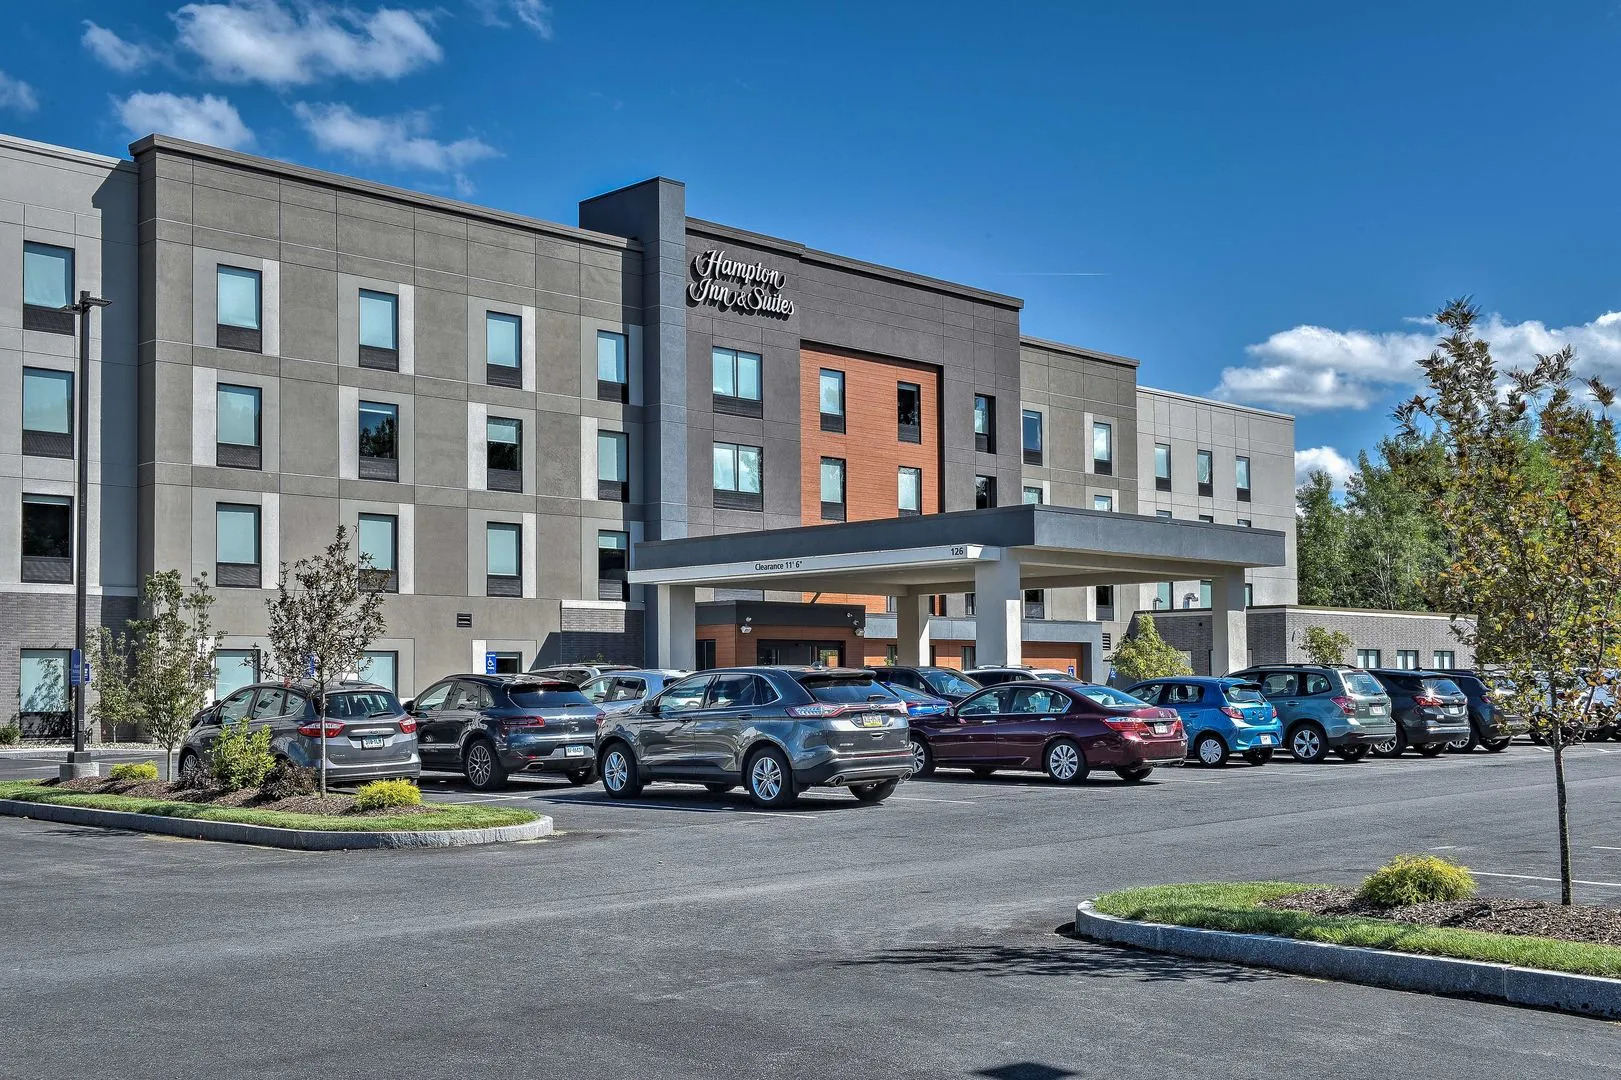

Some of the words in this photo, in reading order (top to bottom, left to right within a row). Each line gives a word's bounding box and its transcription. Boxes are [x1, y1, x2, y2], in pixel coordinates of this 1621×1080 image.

[695, 249, 787, 289] Hampton
[689, 278, 737, 307] Inn
[737, 291, 750, 310] &
[748, 286, 795, 316] Suites
[950, 547, 964, 556] 126
[754, 563, 784, 571] Clearance
